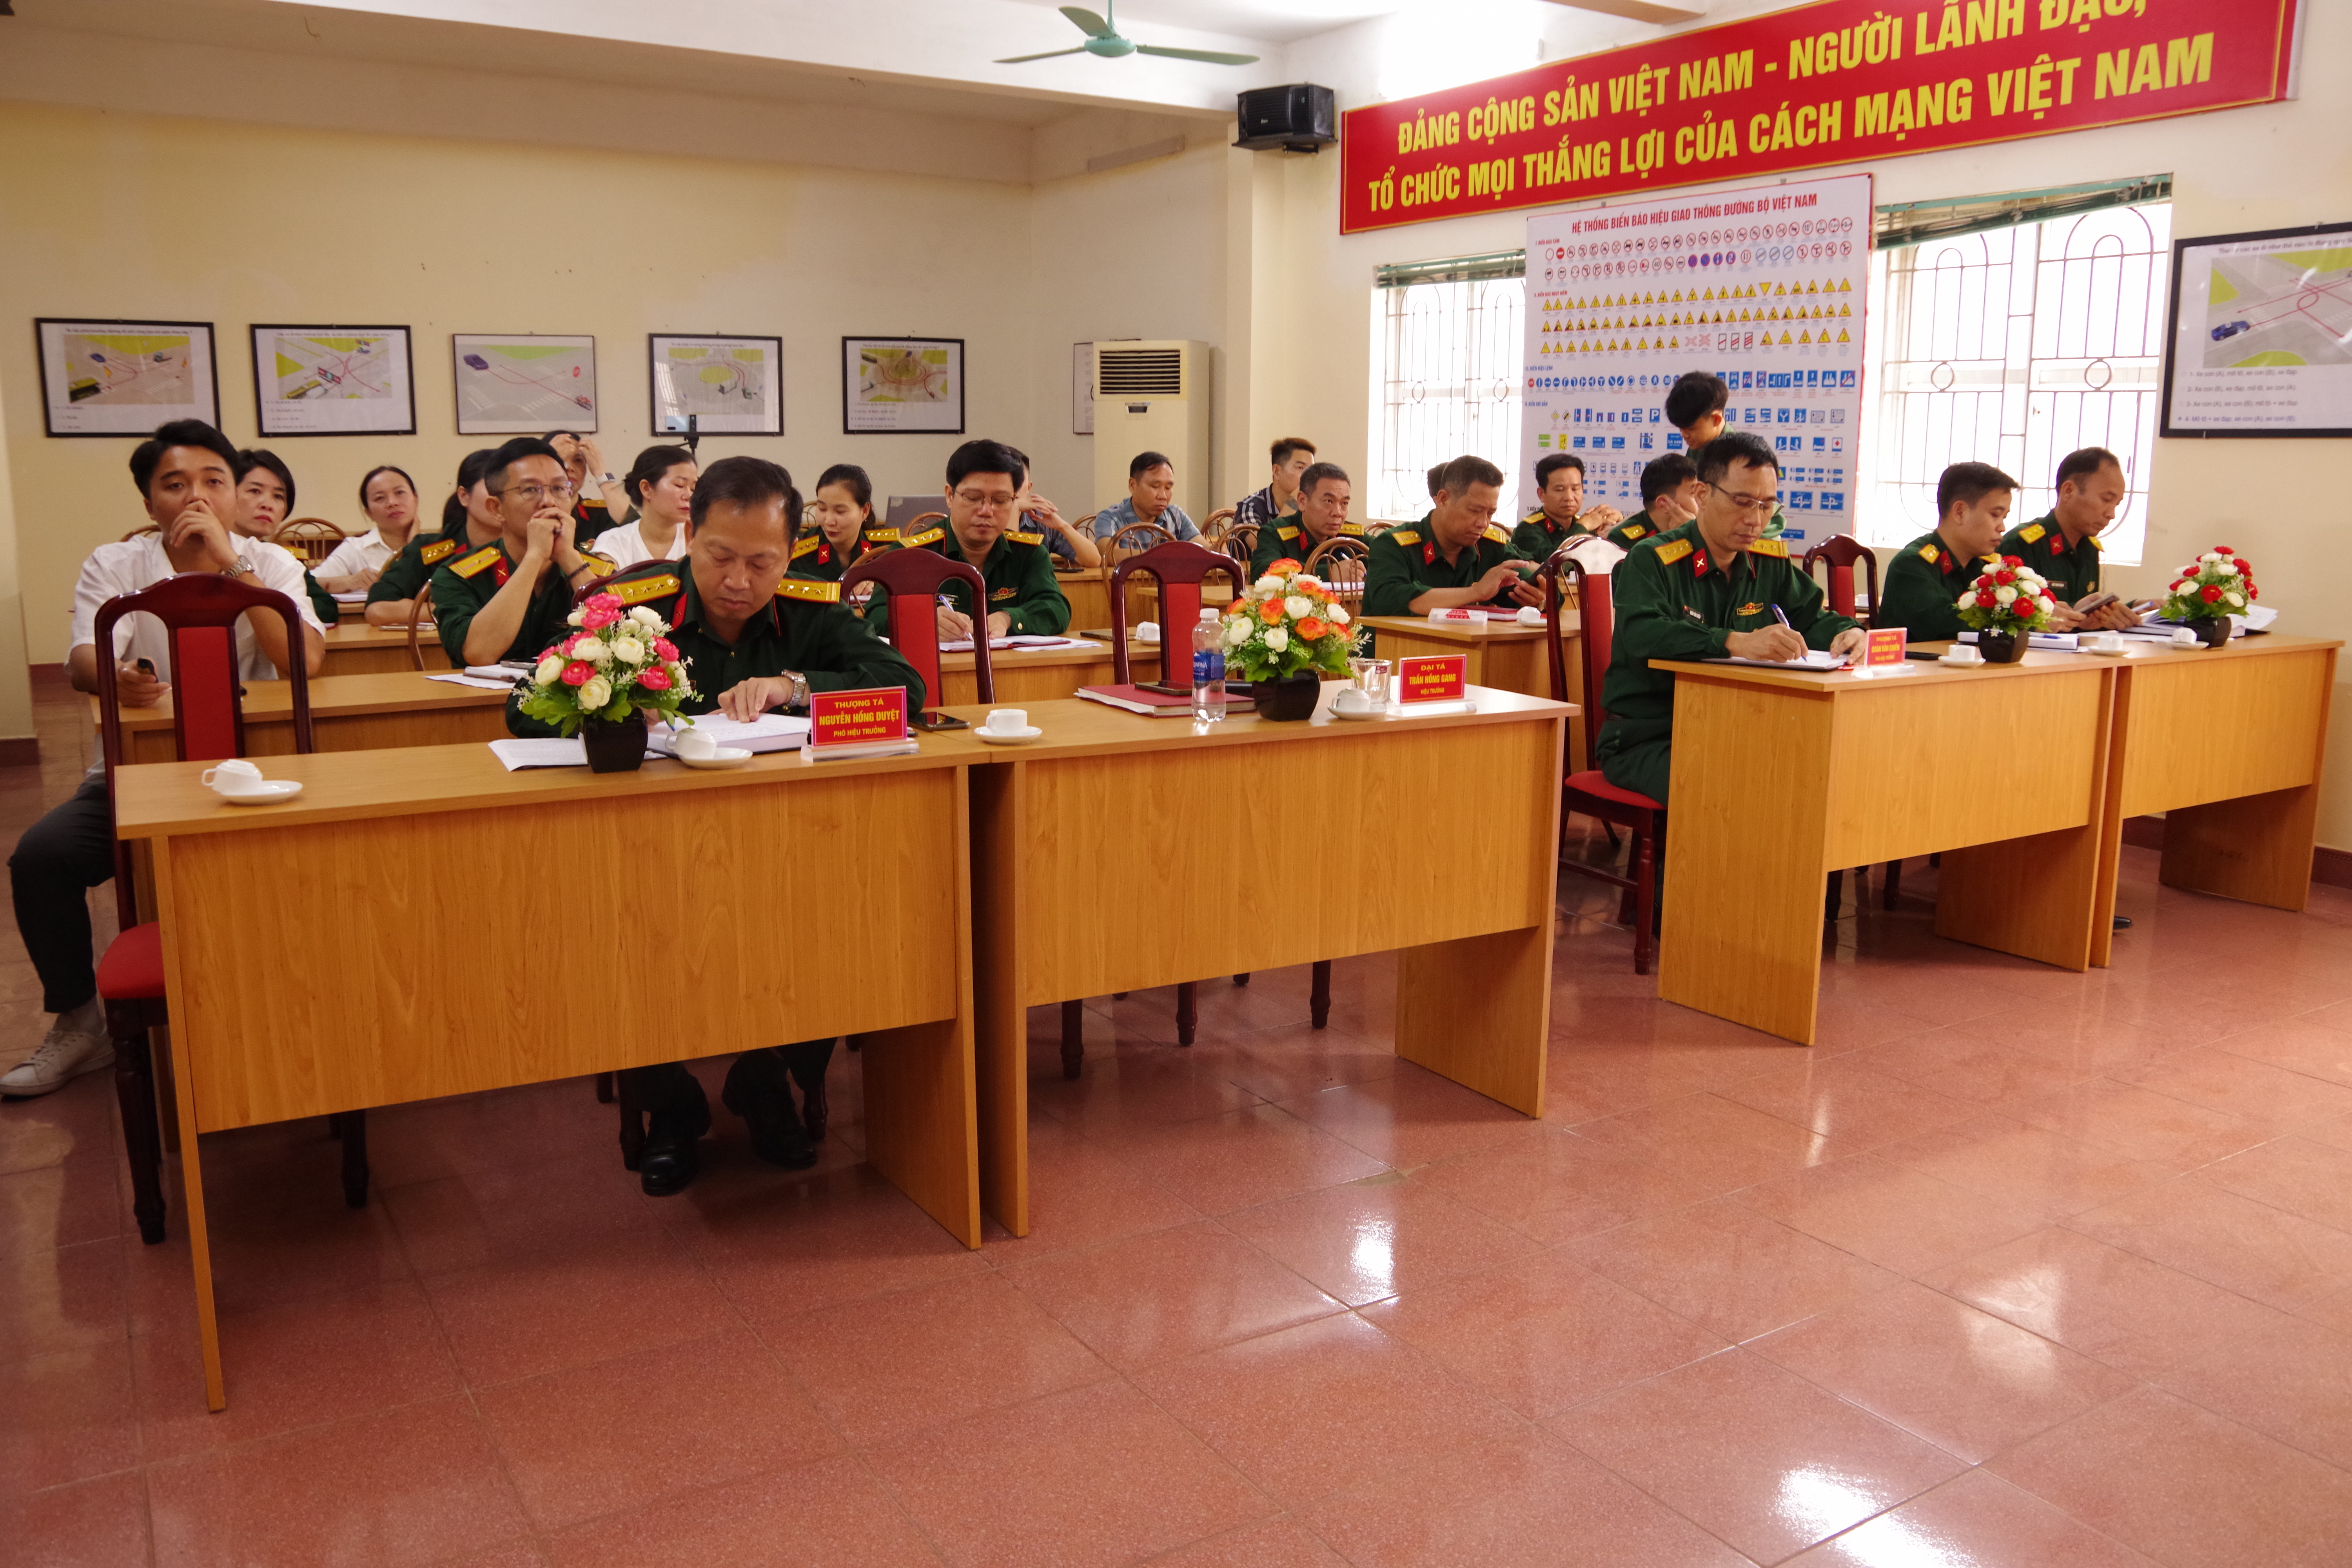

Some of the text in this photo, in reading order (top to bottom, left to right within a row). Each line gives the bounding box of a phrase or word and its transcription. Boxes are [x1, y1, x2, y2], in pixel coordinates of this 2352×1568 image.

[1398, 109, 1459, 154] ĐẢNG
[1468, 97, 1534, 145] CỘNG
[1544, 76, 1599, 125] SẢN
[1609, 64, 1670, 116] VIỆT
[1680, 50, 1753, 100] NAM
[1766, 63, 1777, 71] -
[1789, 11, 1902, 79] NGƯỜI
[1916, 0, 2025, 54] LÃNH
[1369, 33, 2213, 211] TỔ CHỨC MỌI THẮNG LỢI CỦA CÁCH MẠNG VIỆT NAM
[1572, 220, 1581, 235] HỆ
[1584, 216, 1608, 232] THỐNG
[1632, 212, 1648, 226] BÁO
[1650, 209, 1668, 226] HIỆU
[1671, 208, 1691, 222] GIAO
[1693, 203, 1721, 219] THÔNG
[1724, 200, 1754, 216] ĐƯỜNG
[1758, 196, 1769, 214] BỘ
[1773, 194, 1792, 212] VIỆT
[1795, 193, 1817, 208] NAM
[1441, 673, 1456, 682] GANG
[1421, 688, 1429, 696] HIỆU
[835, 697, 884, 709] THƯỢNG TÁ
[819, 708, 900, 726] NGUYỄN HỒNG DUYỆT
[833, 725, 886, 737] PHÓ HIỆU TRƯỞNG
